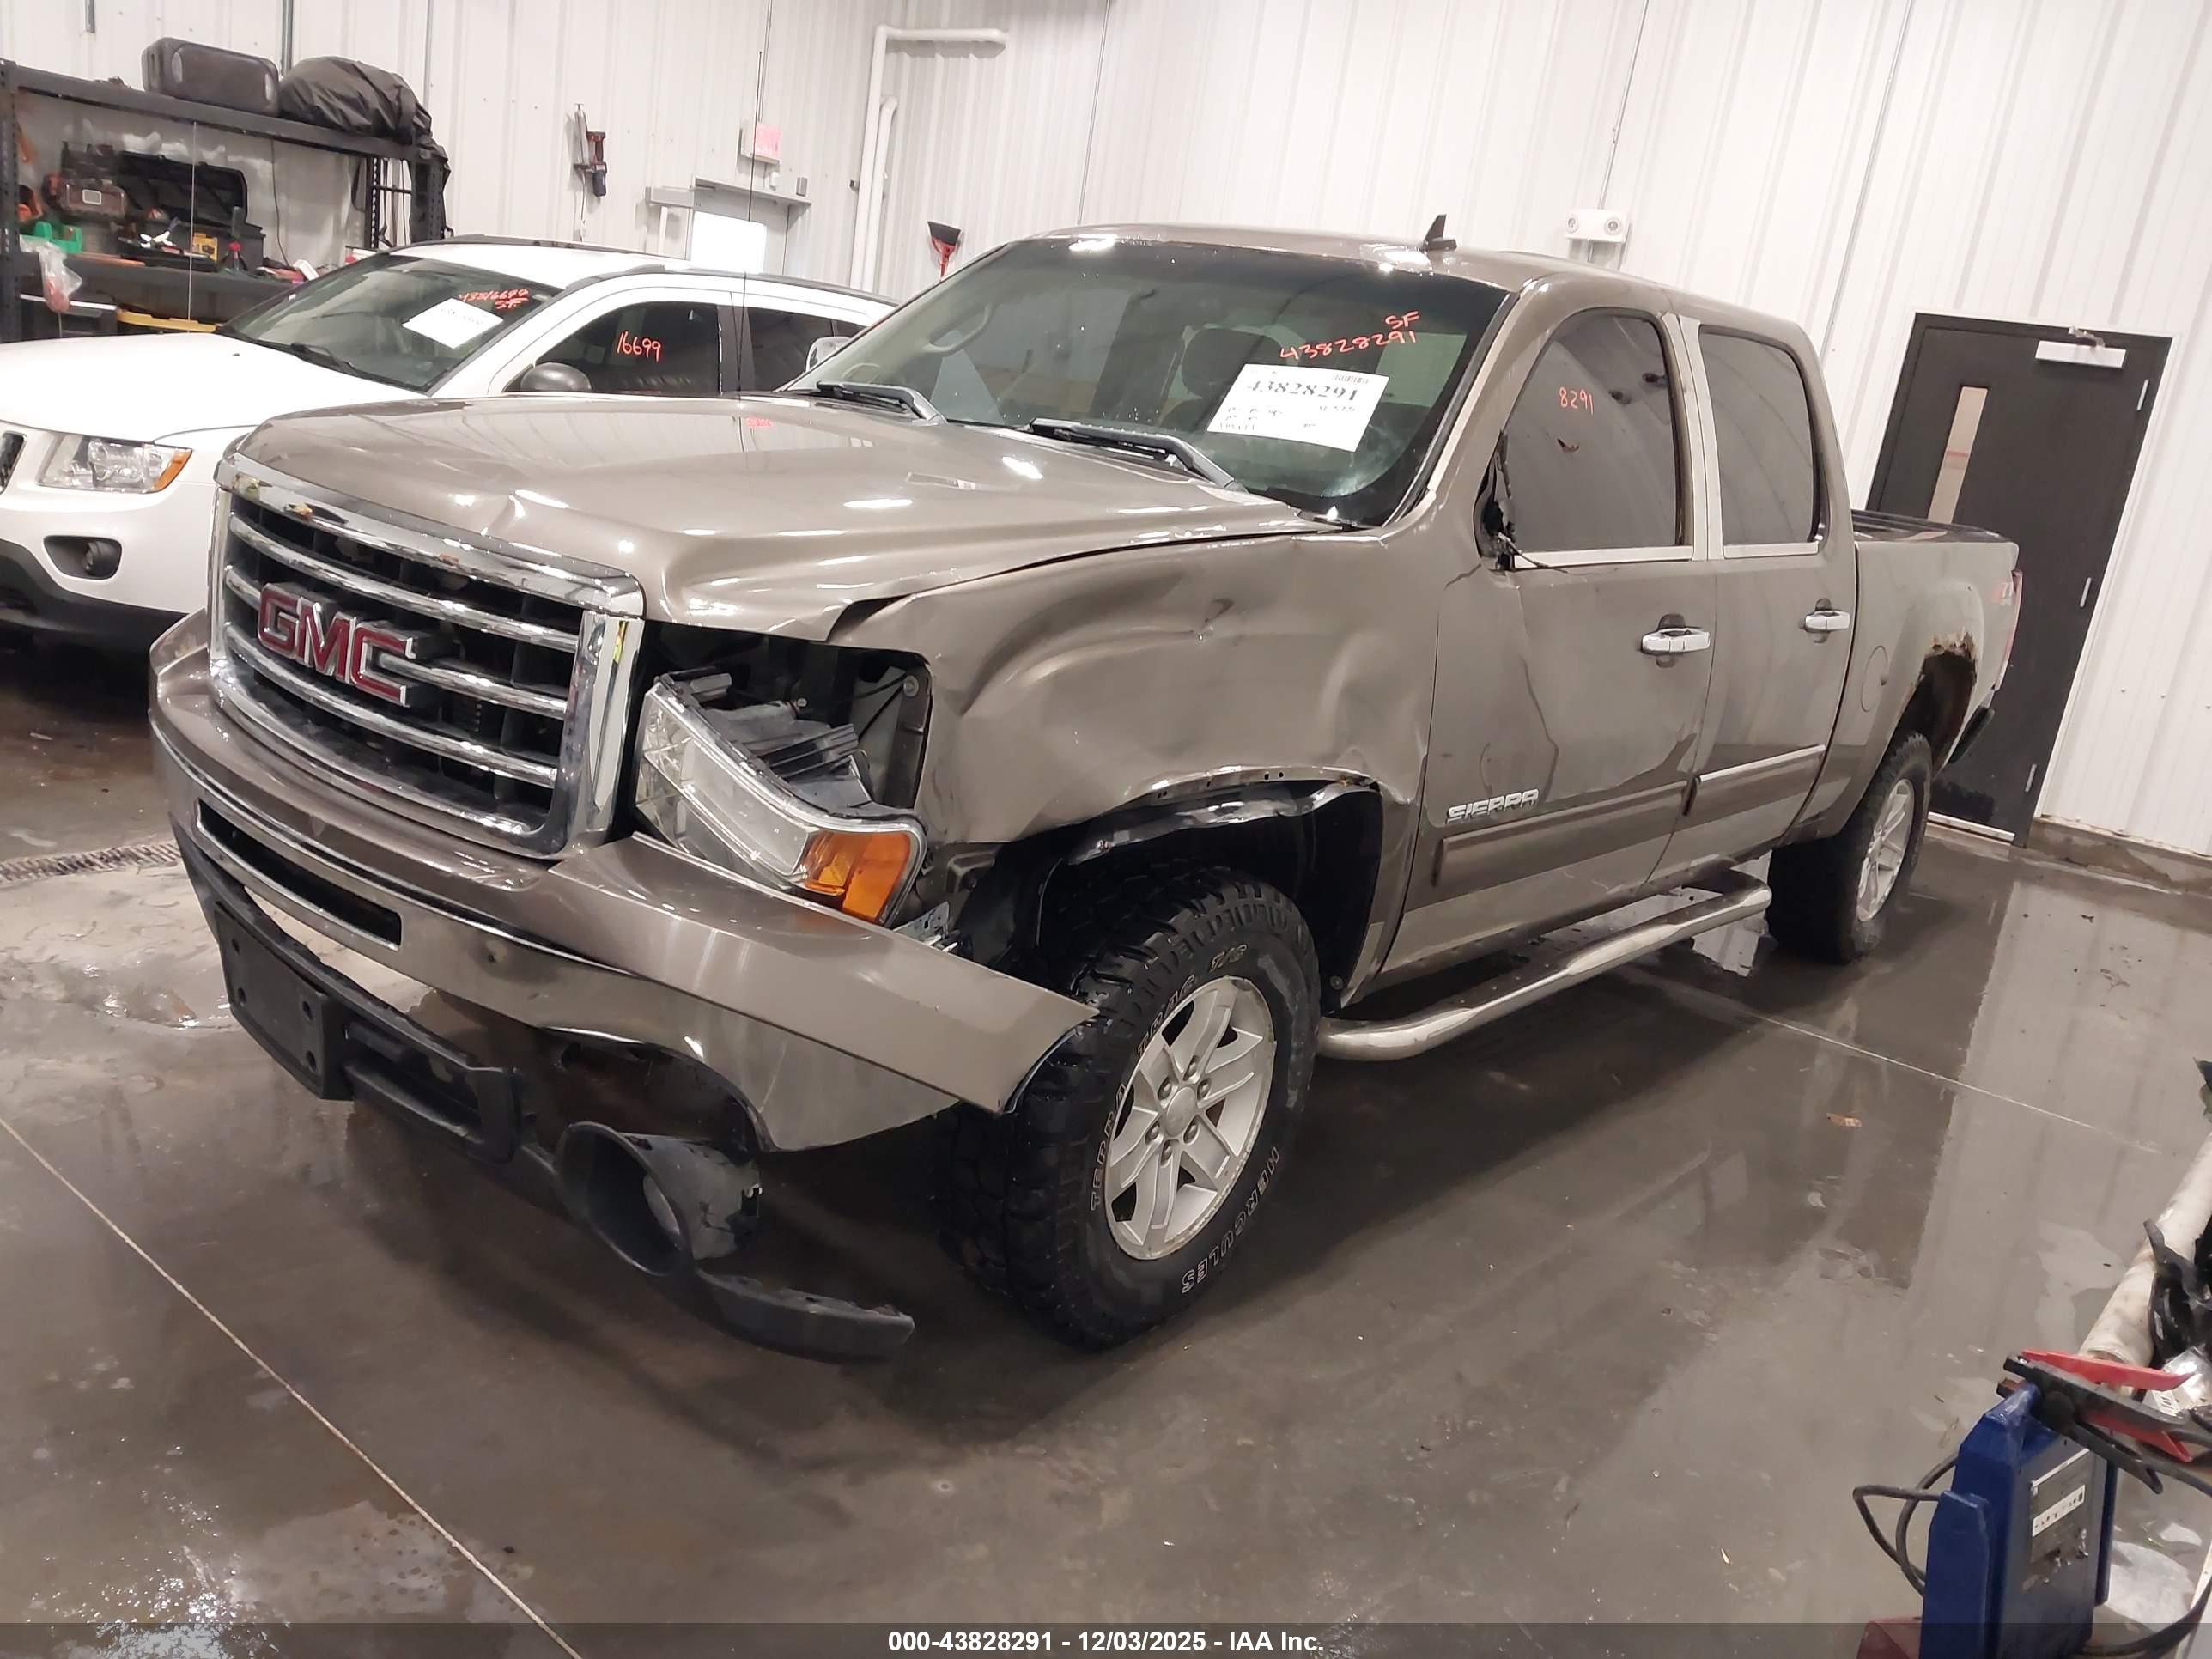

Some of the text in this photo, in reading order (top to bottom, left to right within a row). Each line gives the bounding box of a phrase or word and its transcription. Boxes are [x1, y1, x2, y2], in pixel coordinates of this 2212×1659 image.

[1384, 310, 1420, 330] SF
[617, 331, 661, 362] 16699
[1279, 330, 1417, 360] 43828291
[1248, 380, 1358, 401] 43828291
[1559, 386, 1595, 416] 8291
[258, 582, 416, 708] GMC
[1446, 788, 1540, 824] SIERRA
[1182, 1146, 1280, 1294] HERCULES
